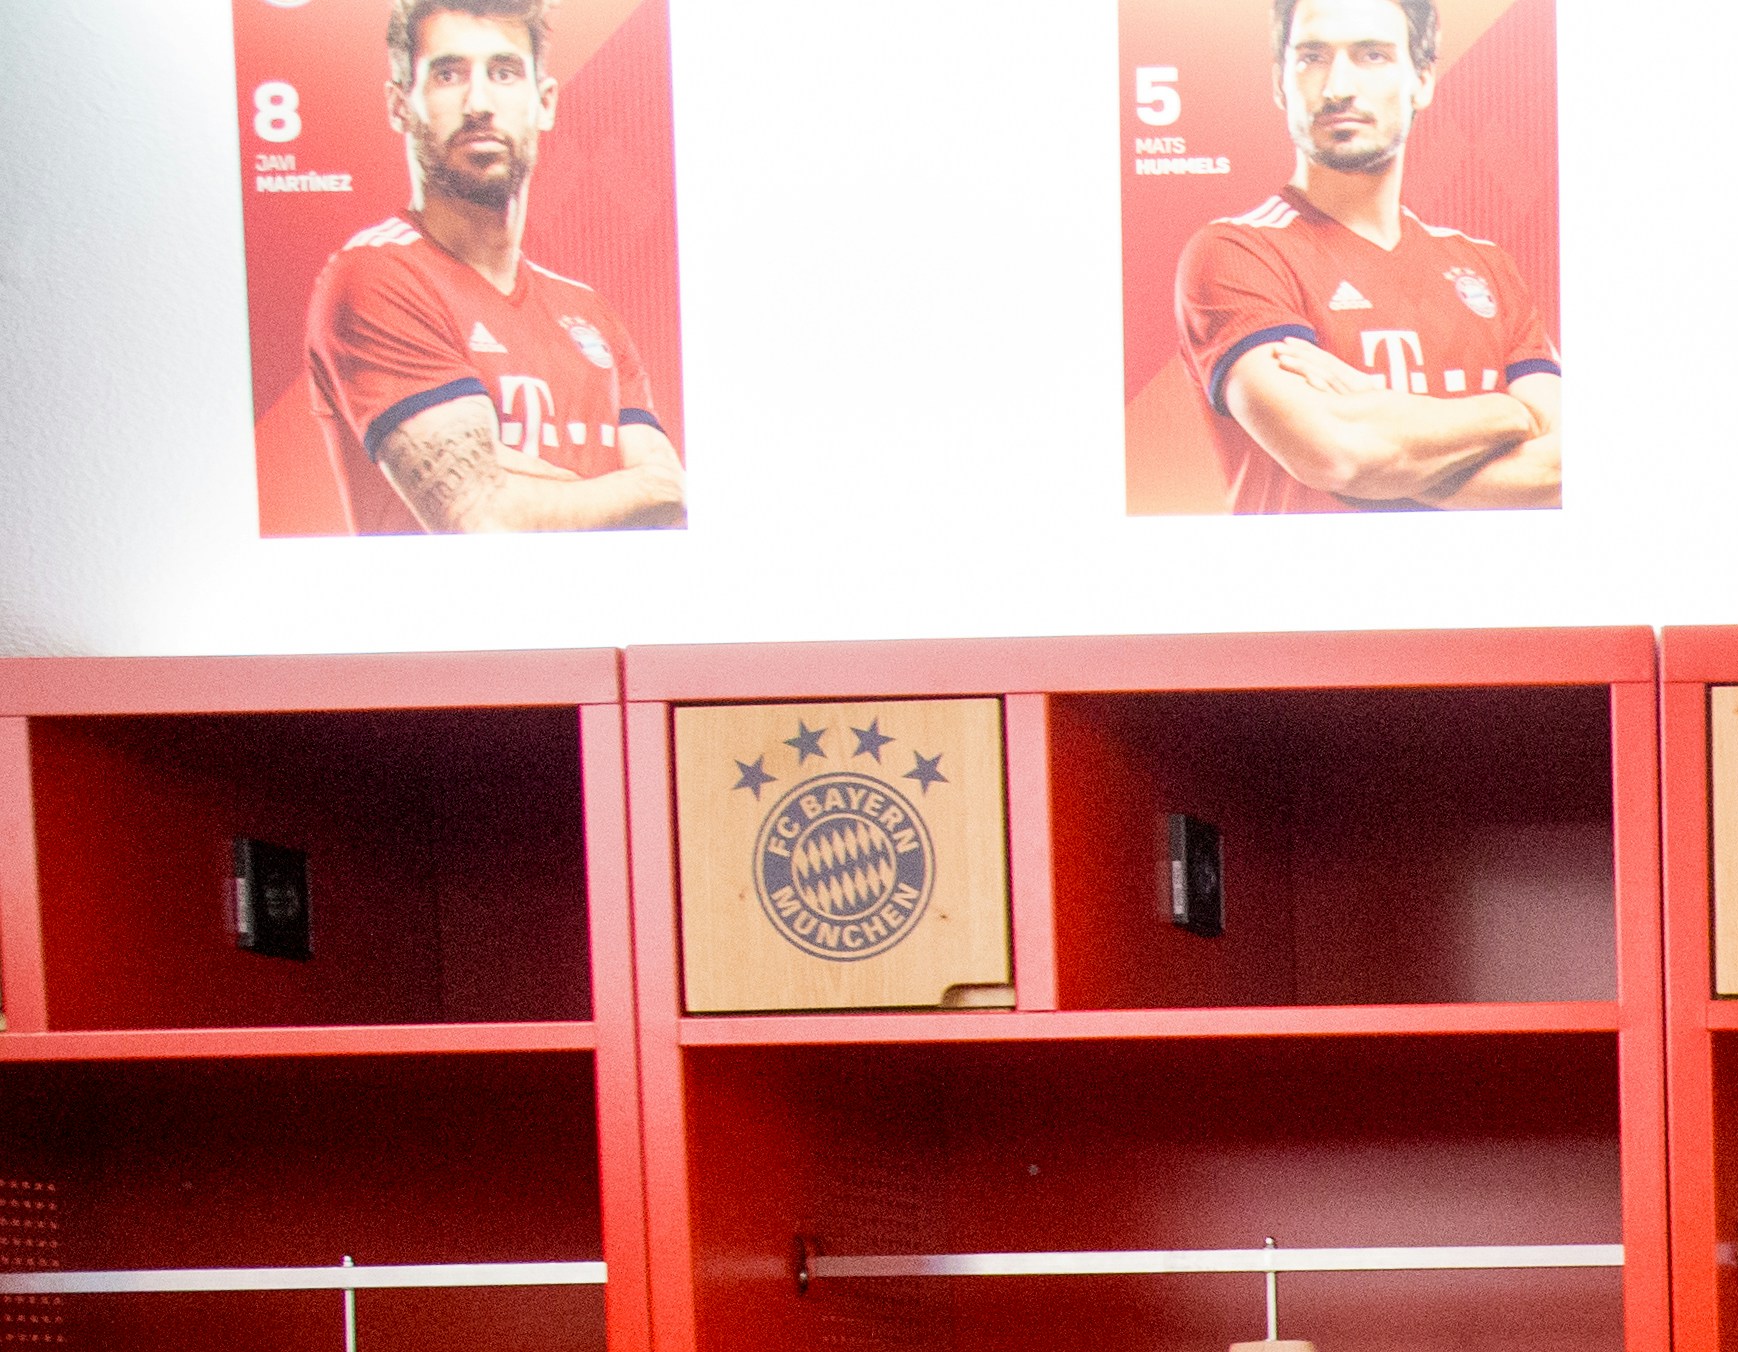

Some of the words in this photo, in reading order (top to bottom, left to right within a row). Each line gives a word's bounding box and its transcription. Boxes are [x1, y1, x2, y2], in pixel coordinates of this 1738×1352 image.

[1136, 66, 1180, 125] 5
[255, 82, 301, 142] 8
[1136, 137, 1185, 153] MATS
[256, 155, 295, 172] JAVI
[1136, 156, 1230, 174] HUMMELS
[257, 171, 352, 192] MARTÍNEZ
[768, 816, 799, 858] FC
[802, 787, 919, 855] BAYERN
